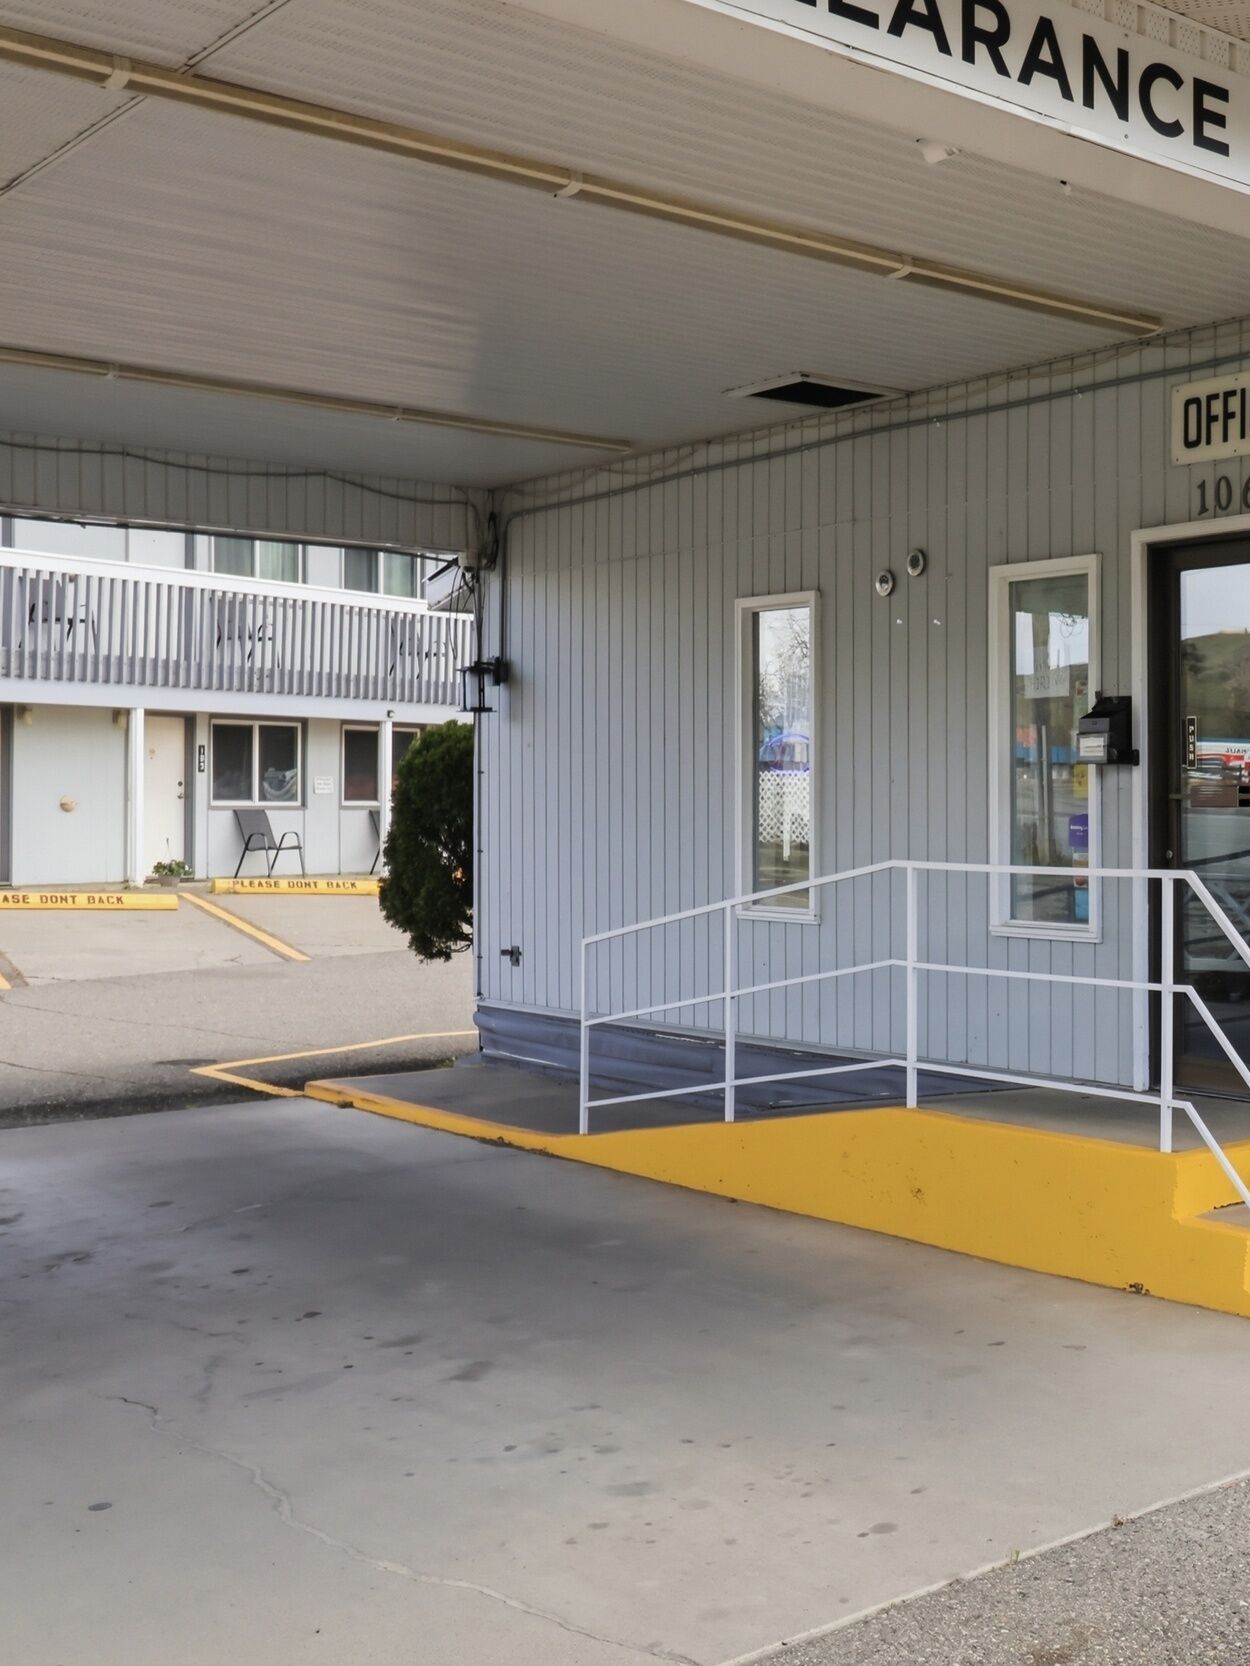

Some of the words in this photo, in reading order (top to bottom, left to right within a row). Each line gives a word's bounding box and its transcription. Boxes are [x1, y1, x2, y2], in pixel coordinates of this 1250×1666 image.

[795, 0, 1230, 157] ARANCE
[232, 880, 280, 889] PLEASE
[288, 880, 318, 889] DONT
[327, 880, 358, 889] BACK
[40, 894, 77, 905] DONT
[87, 895, 124, 905] BACK
